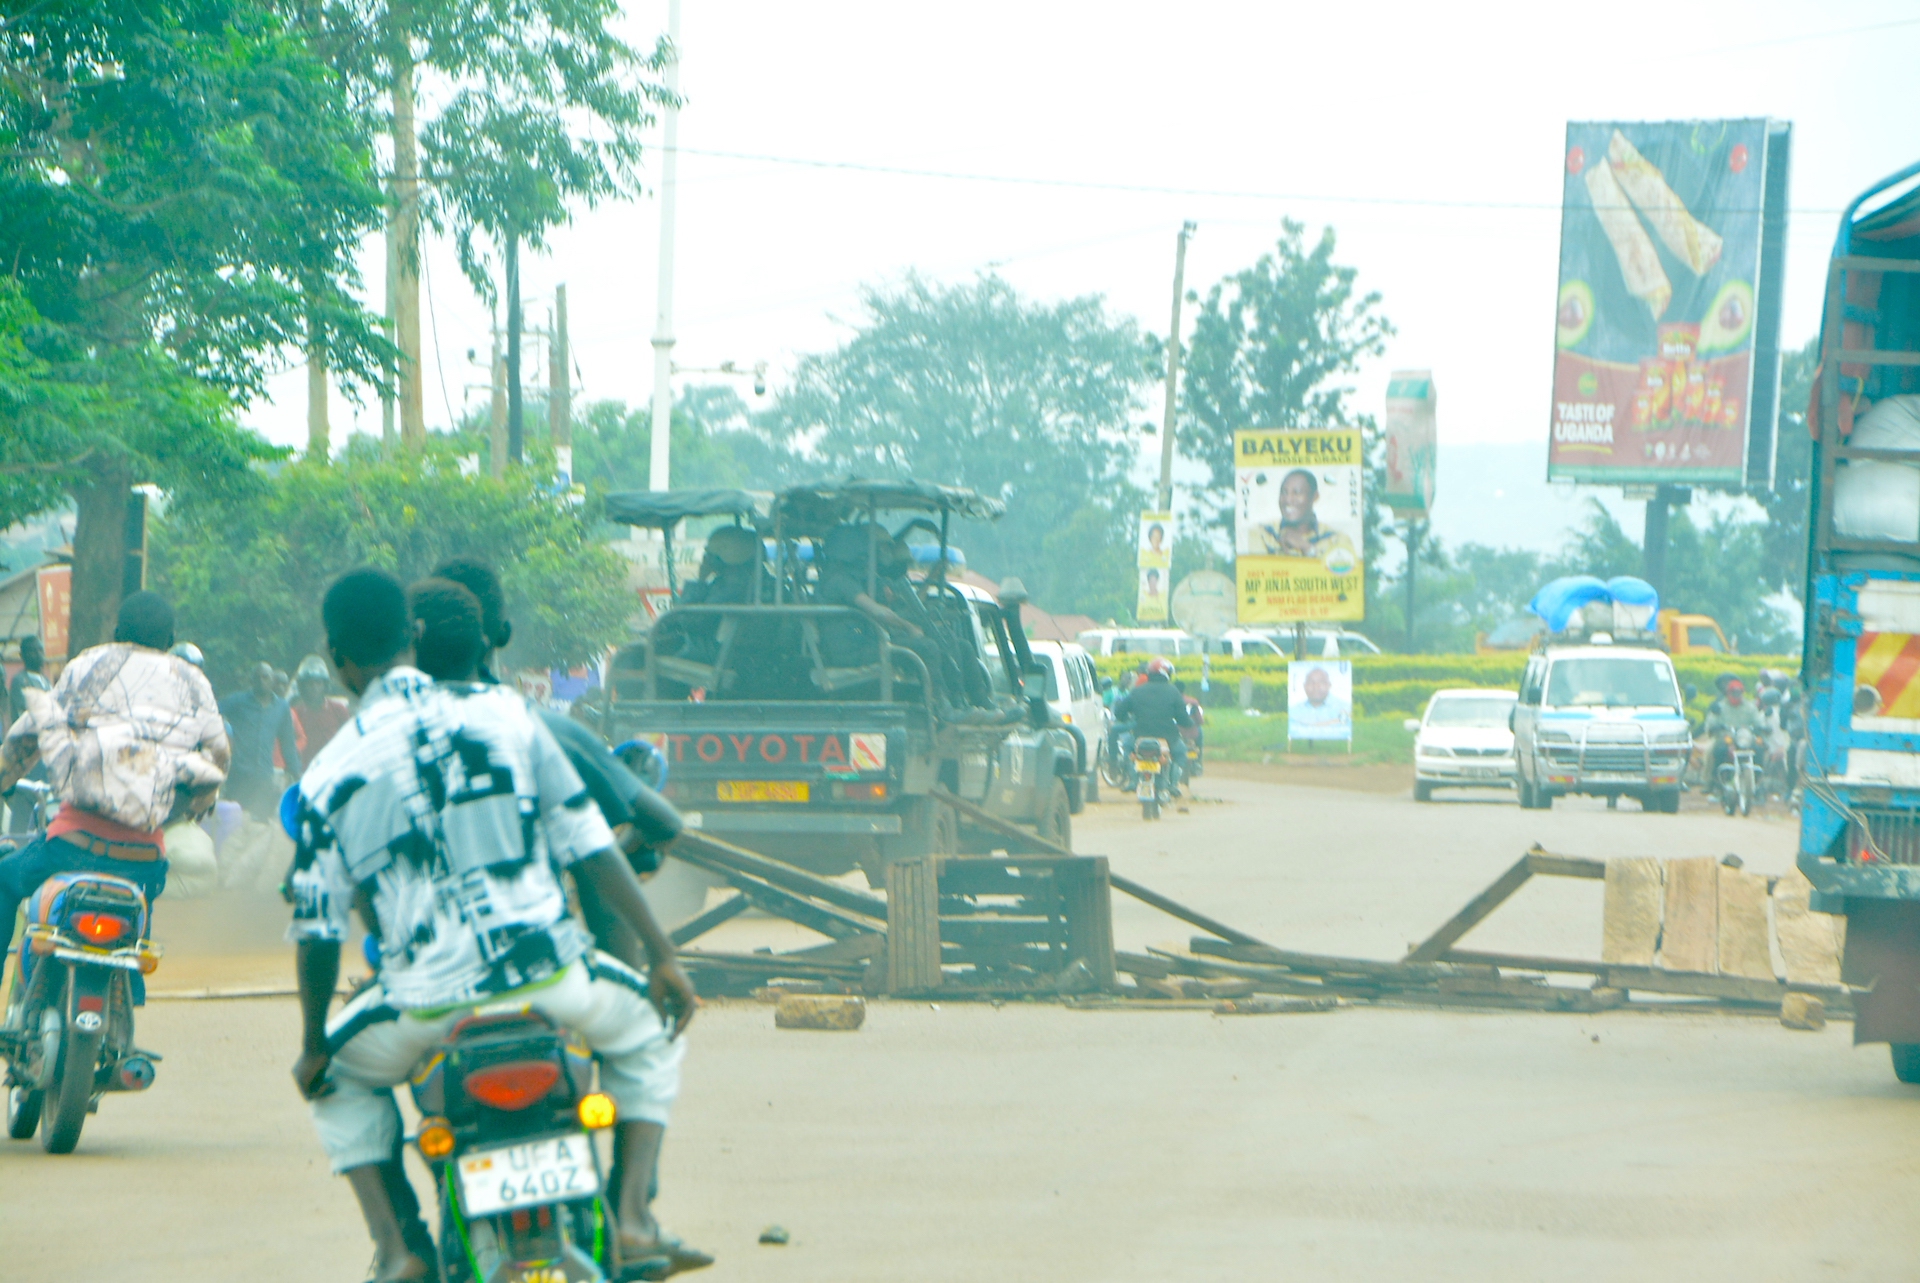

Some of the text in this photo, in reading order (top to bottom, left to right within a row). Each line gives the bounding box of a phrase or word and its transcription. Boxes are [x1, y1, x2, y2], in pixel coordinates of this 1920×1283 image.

[1557, 403, 1595, 422] TASTE
[1596, 403, 1615, 423] OF
[1555, 421, 1614, 444] UGANDA
[1242, 436, 1352, 455] BALYEKU
[1245, 575, 1358, 594] MP JINJA SOUTH WEST
[669, 734, 846, 763] TOYOTA
[508, 1139, 574, 1171] UFA
